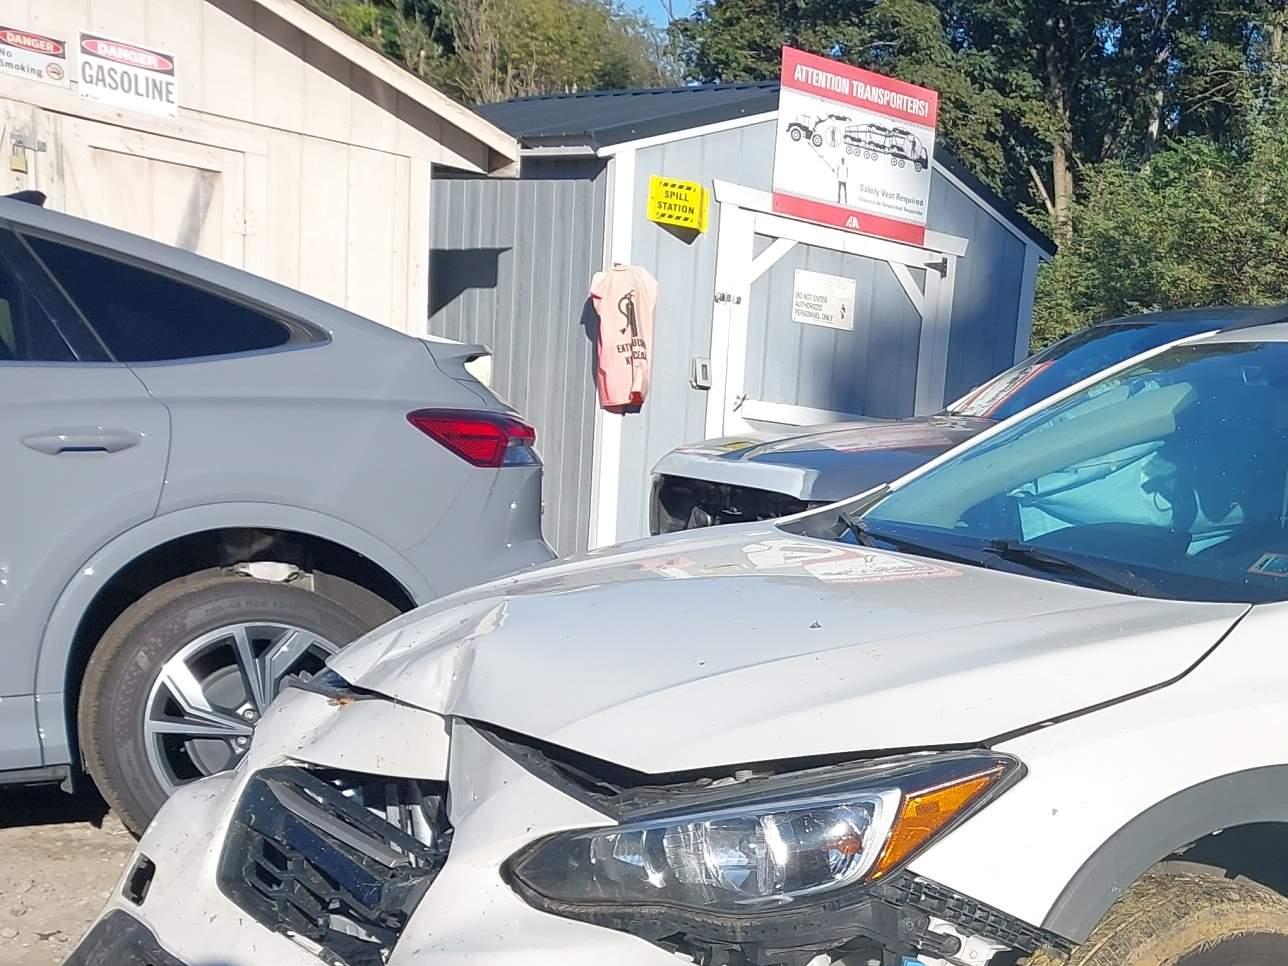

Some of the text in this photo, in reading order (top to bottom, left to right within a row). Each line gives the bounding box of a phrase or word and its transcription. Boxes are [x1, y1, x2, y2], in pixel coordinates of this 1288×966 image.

[6, 32, 54, 53] DANGER
[97, 42, 158, 69] DANGER
[81, 61, 175, 104] GASOLINE
[793, 64, 929, 117] ATTENTION TRANSPORTERS!
[664, 190, 689, 202] SPILL
[896, 192, 924, 207] Required
[656, 200, 695, 215] STATION
